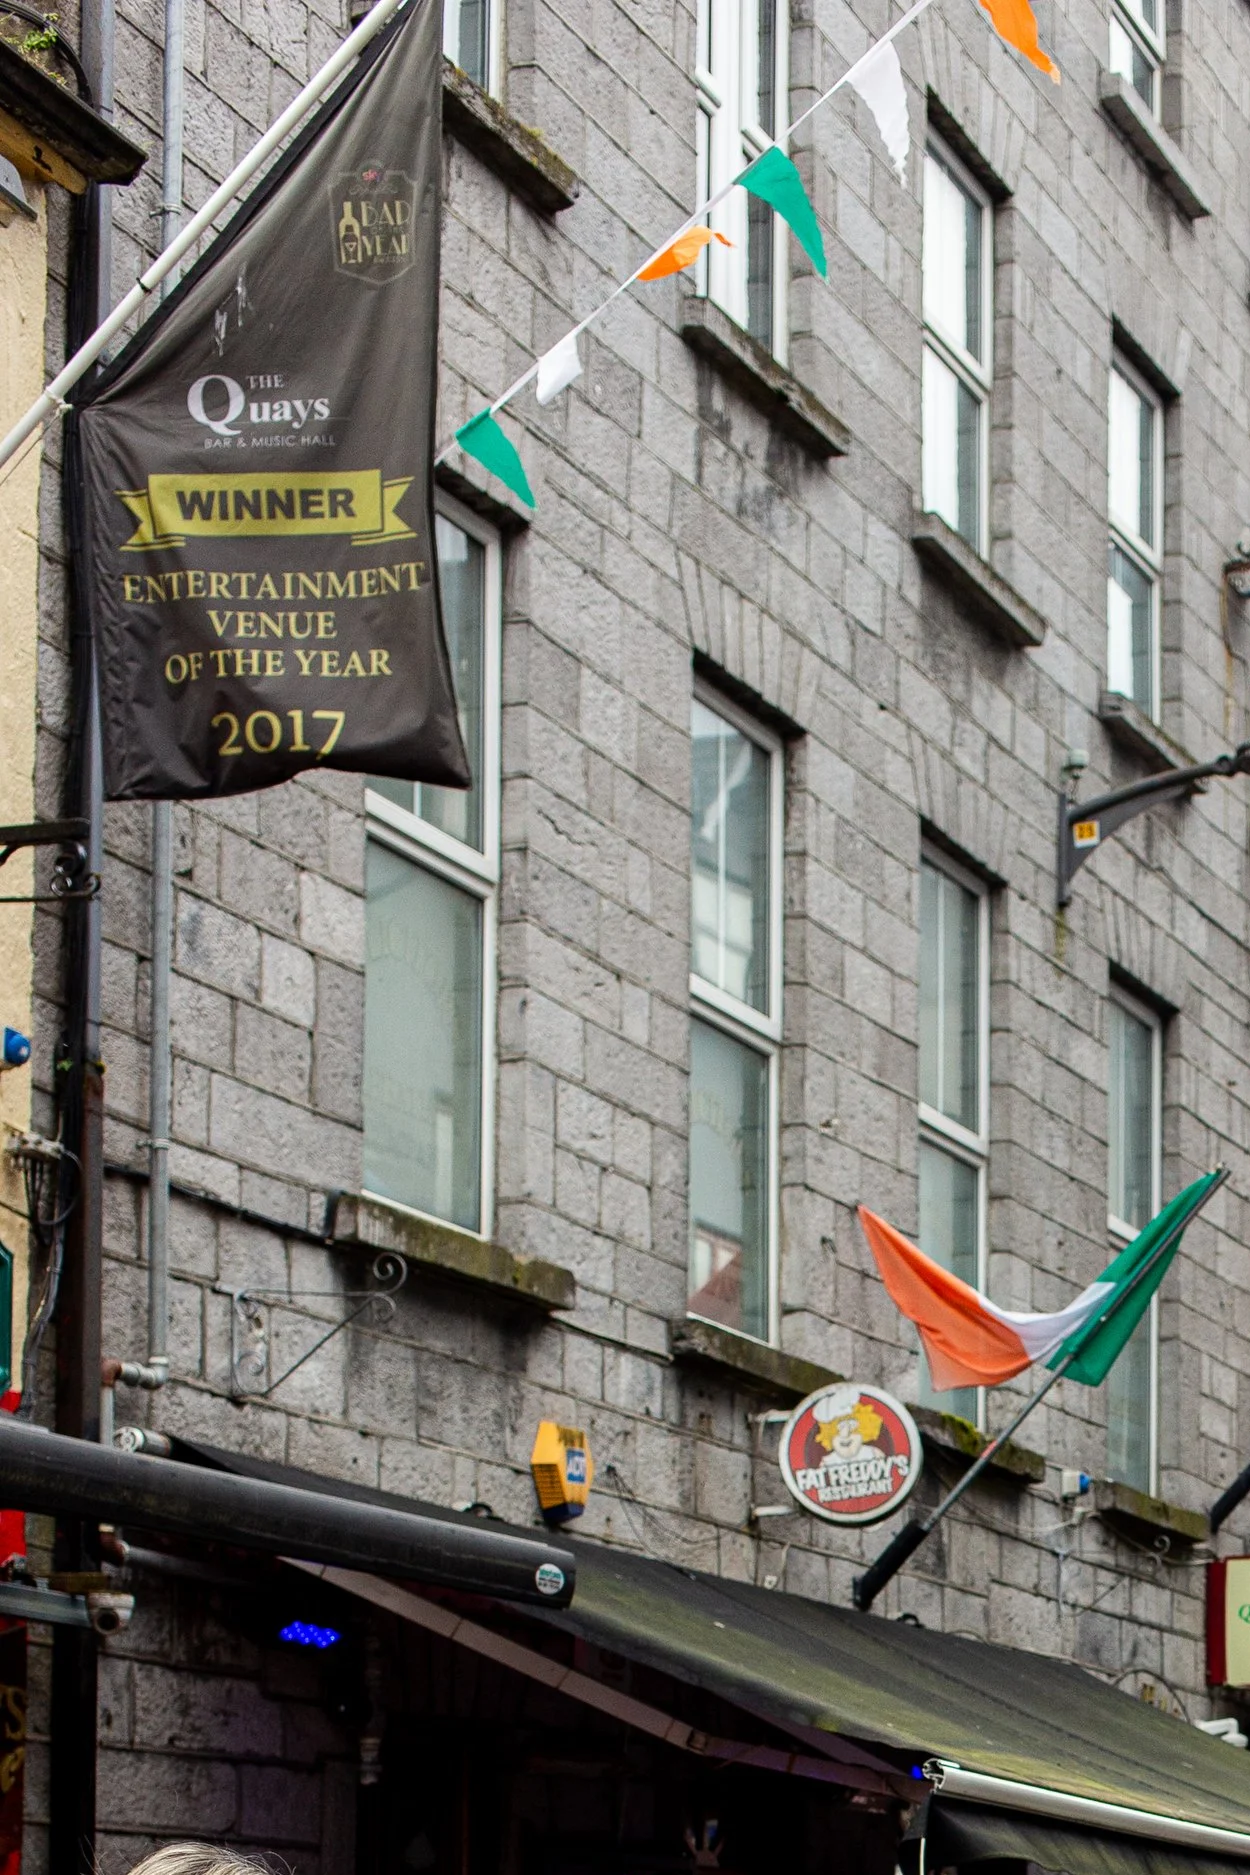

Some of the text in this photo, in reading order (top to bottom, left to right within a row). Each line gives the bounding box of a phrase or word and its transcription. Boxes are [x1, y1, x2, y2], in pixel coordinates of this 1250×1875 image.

[248, 374, 284, 389] THE
[187, 374, 331, 436] Quays
[205, 435, 336, 449] BAR & MUSIC HALL
[176, 488, 358, 521] WINNER
[122, 561, 425, 603] ENTERTAINMENT
[208, 610, 338, 639] VENUE
[165, 649, 393, 684] OF THE YEAR
[211, 709, 346, 760] 2017
[796, 1466, 828, 1491] FAT
